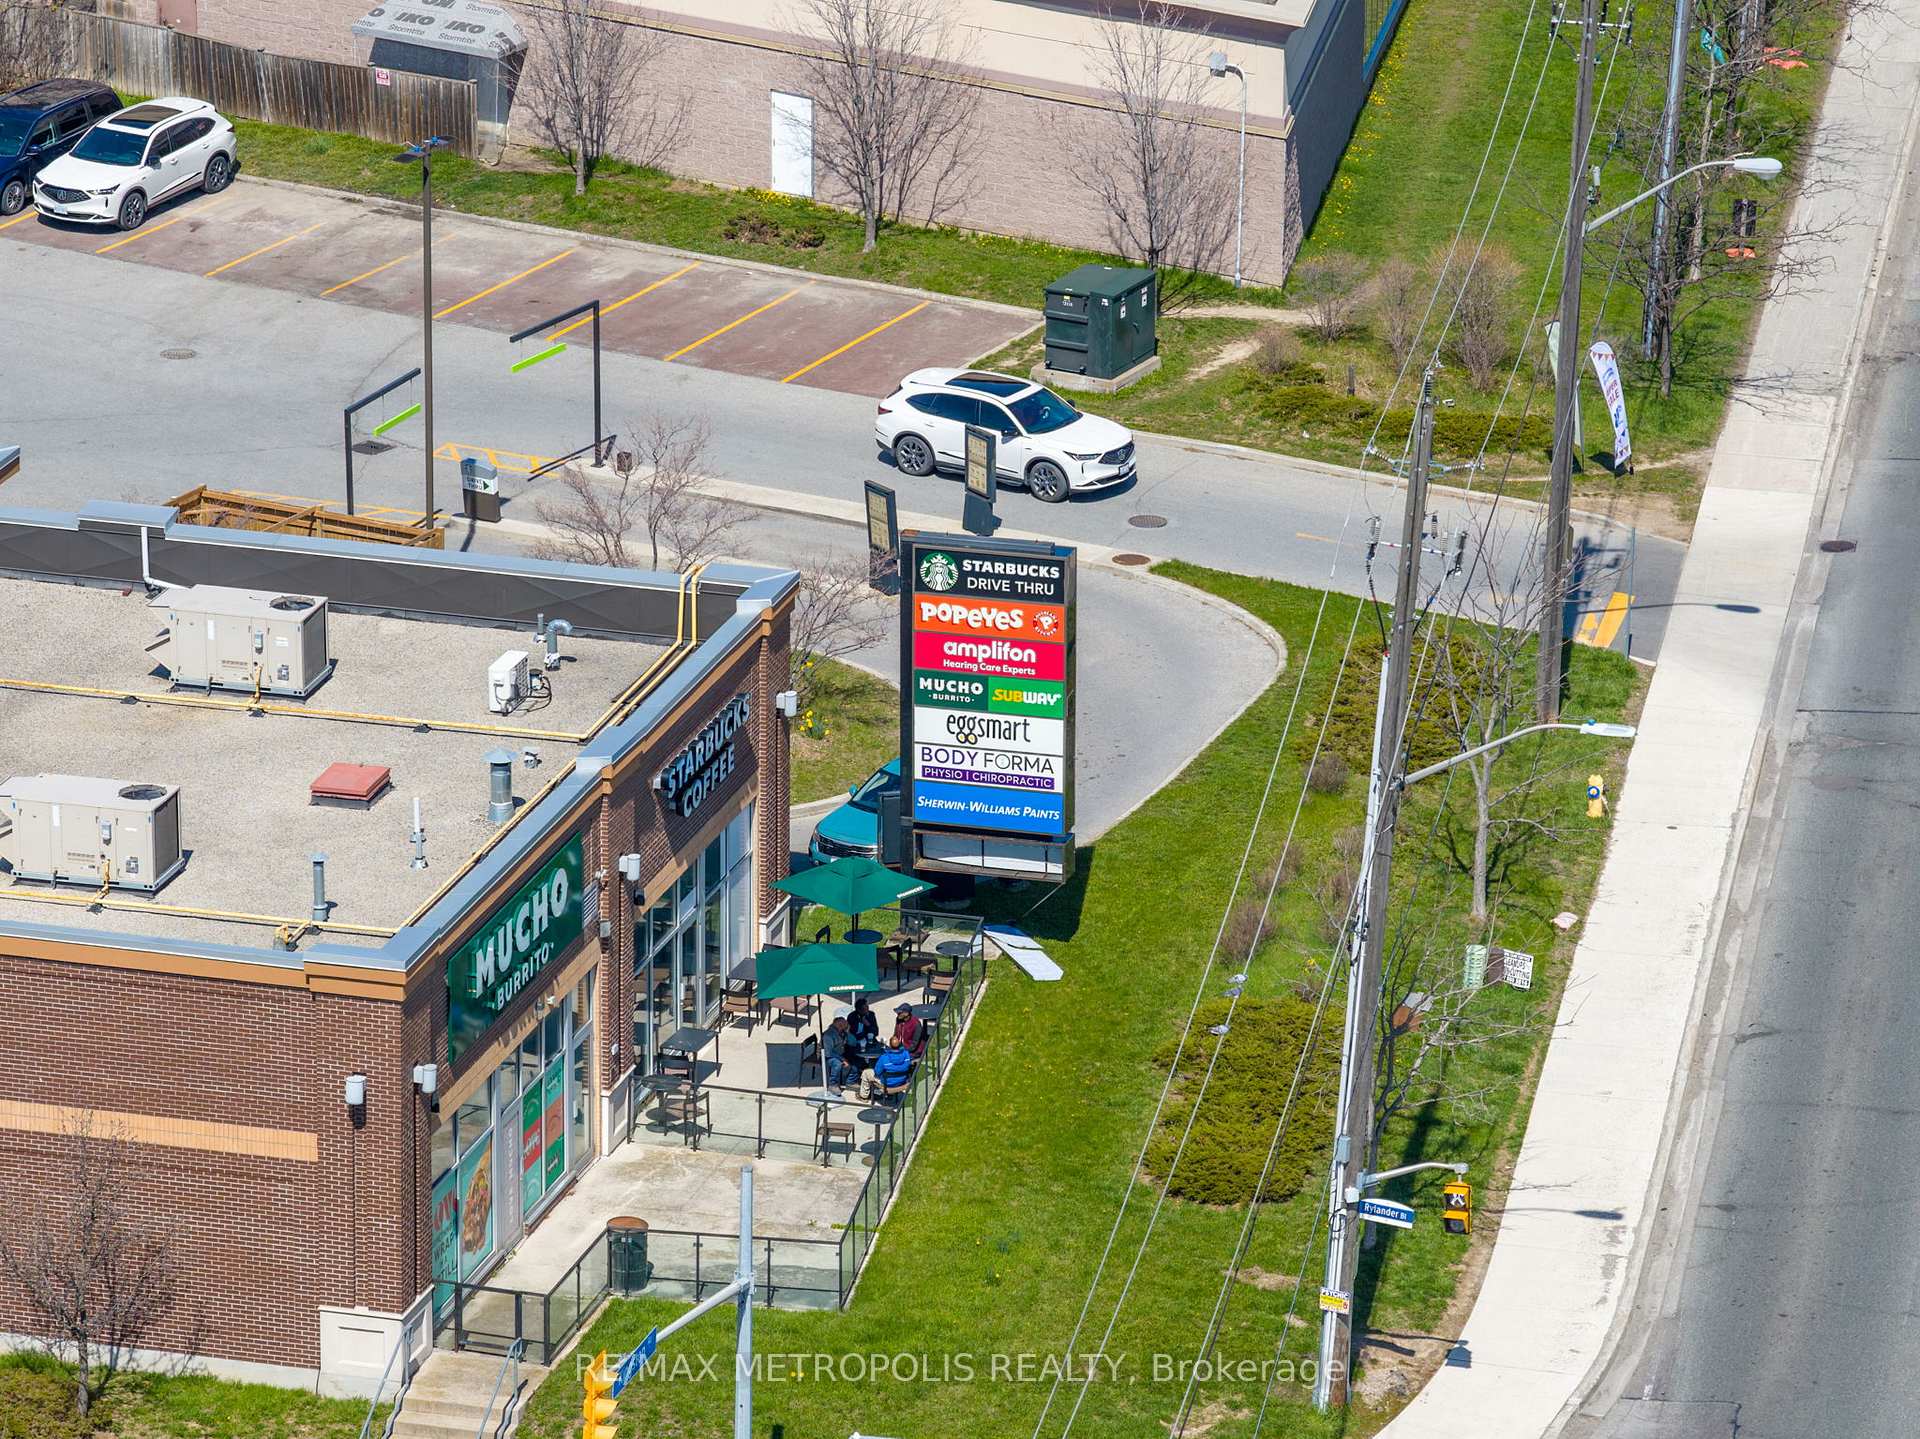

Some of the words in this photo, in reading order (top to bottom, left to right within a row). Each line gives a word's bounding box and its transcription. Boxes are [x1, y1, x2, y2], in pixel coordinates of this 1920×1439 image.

[394, 12, 435, 25] IKO
[445, 21, 485, 34] IKO
[388, 24, 425, 35] Stormtite
[438, 32, 475, 44] Stormtite
[962, 559, 1060, 578] STARBUCKS
[967, 577, 1011, 592] DRIVE
[1015, 581, 1054, 595] THRU
[943, 641, 1036, 663] amplifon
[943, 659, 978, 672] Hearing
[980, 663, 1001, 673] Care
[1002, 665, 1036, 676] Experts
[919, 677, 984, 695] MUCHO
[992, 689, 1062, 706] SUBWAY
[947, 714, 1031, 745] eggsmart
[666, 695, 750, 799] STARBUCKS
[921, 747, 979, 766] BODY
[984, 752, 1054, 774] FORMA
[682, 743, 735, 818] COFFEE
[924, 768, 963, 781] PHYSIO
[972, 772, 1052, 788] CHIROPRACTIC
[1023, 806, 1060, 820] PAINTS
[475, 867, 569, 999] MUCHO
[496, 944, 550, 1011] BURRITO
[1364, 1202, 1399, 1218] Rylander
